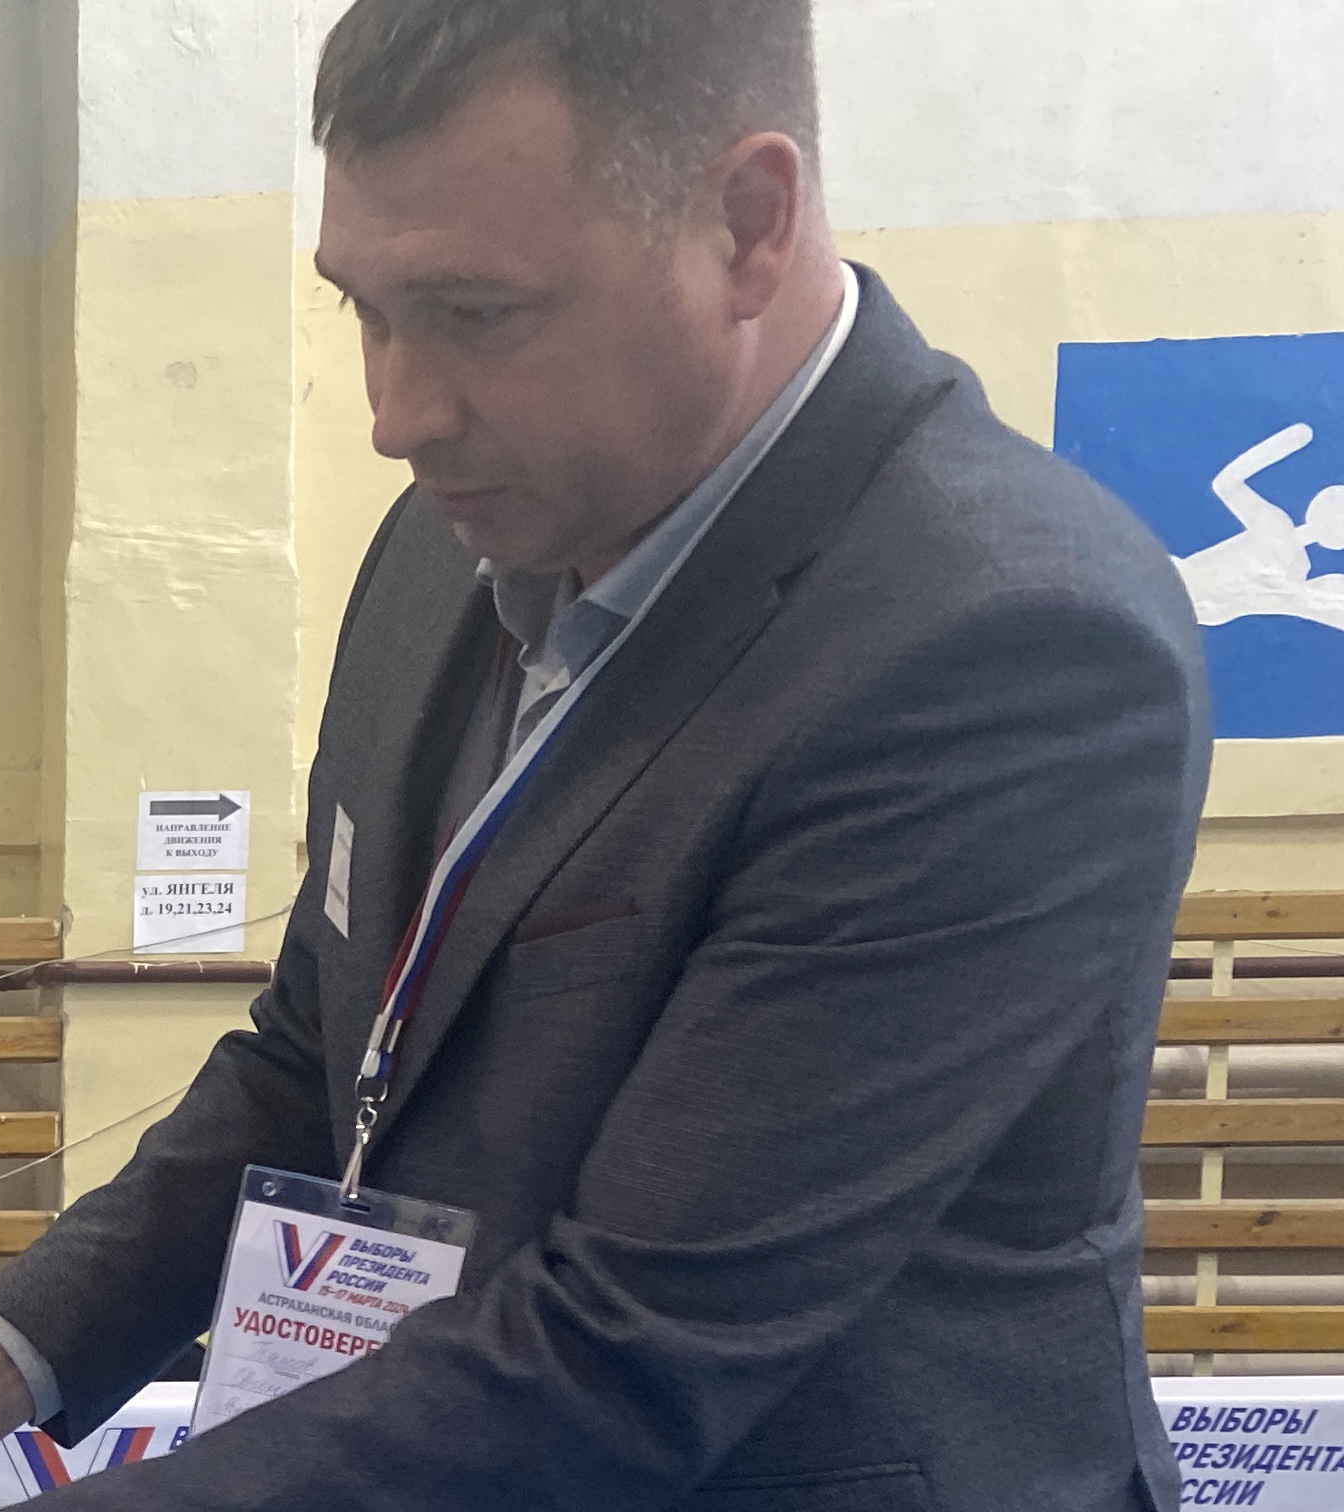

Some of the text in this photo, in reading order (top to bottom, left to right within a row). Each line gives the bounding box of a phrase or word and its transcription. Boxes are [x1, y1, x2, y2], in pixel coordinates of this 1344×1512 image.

[155, 823, 232, 832] НАПРАВЛЕНИЕ
[163, 836, 222, 845] ДВИЖЕНИЯ
[166, 848, 220, 857] К ВЫХОДУ
[141, 882, 234, 899] ул. ЯНГЕЛЯ
[140, 906, 154, 916] д.
[350, 1239, 417, 1262] ВЫБОРЫ
[338, 1254, 430, 1285] ПРЕЗИДЕНТА
[327, 1270, 387, 1293] РОССИИ
[258, 1292, 353, 1324] АСТРАХАНСКАЯ
[347, 1293, 383, 1309] МАРТА
[1170, 1406, 1319, 1434] ВЫБОРЫ
